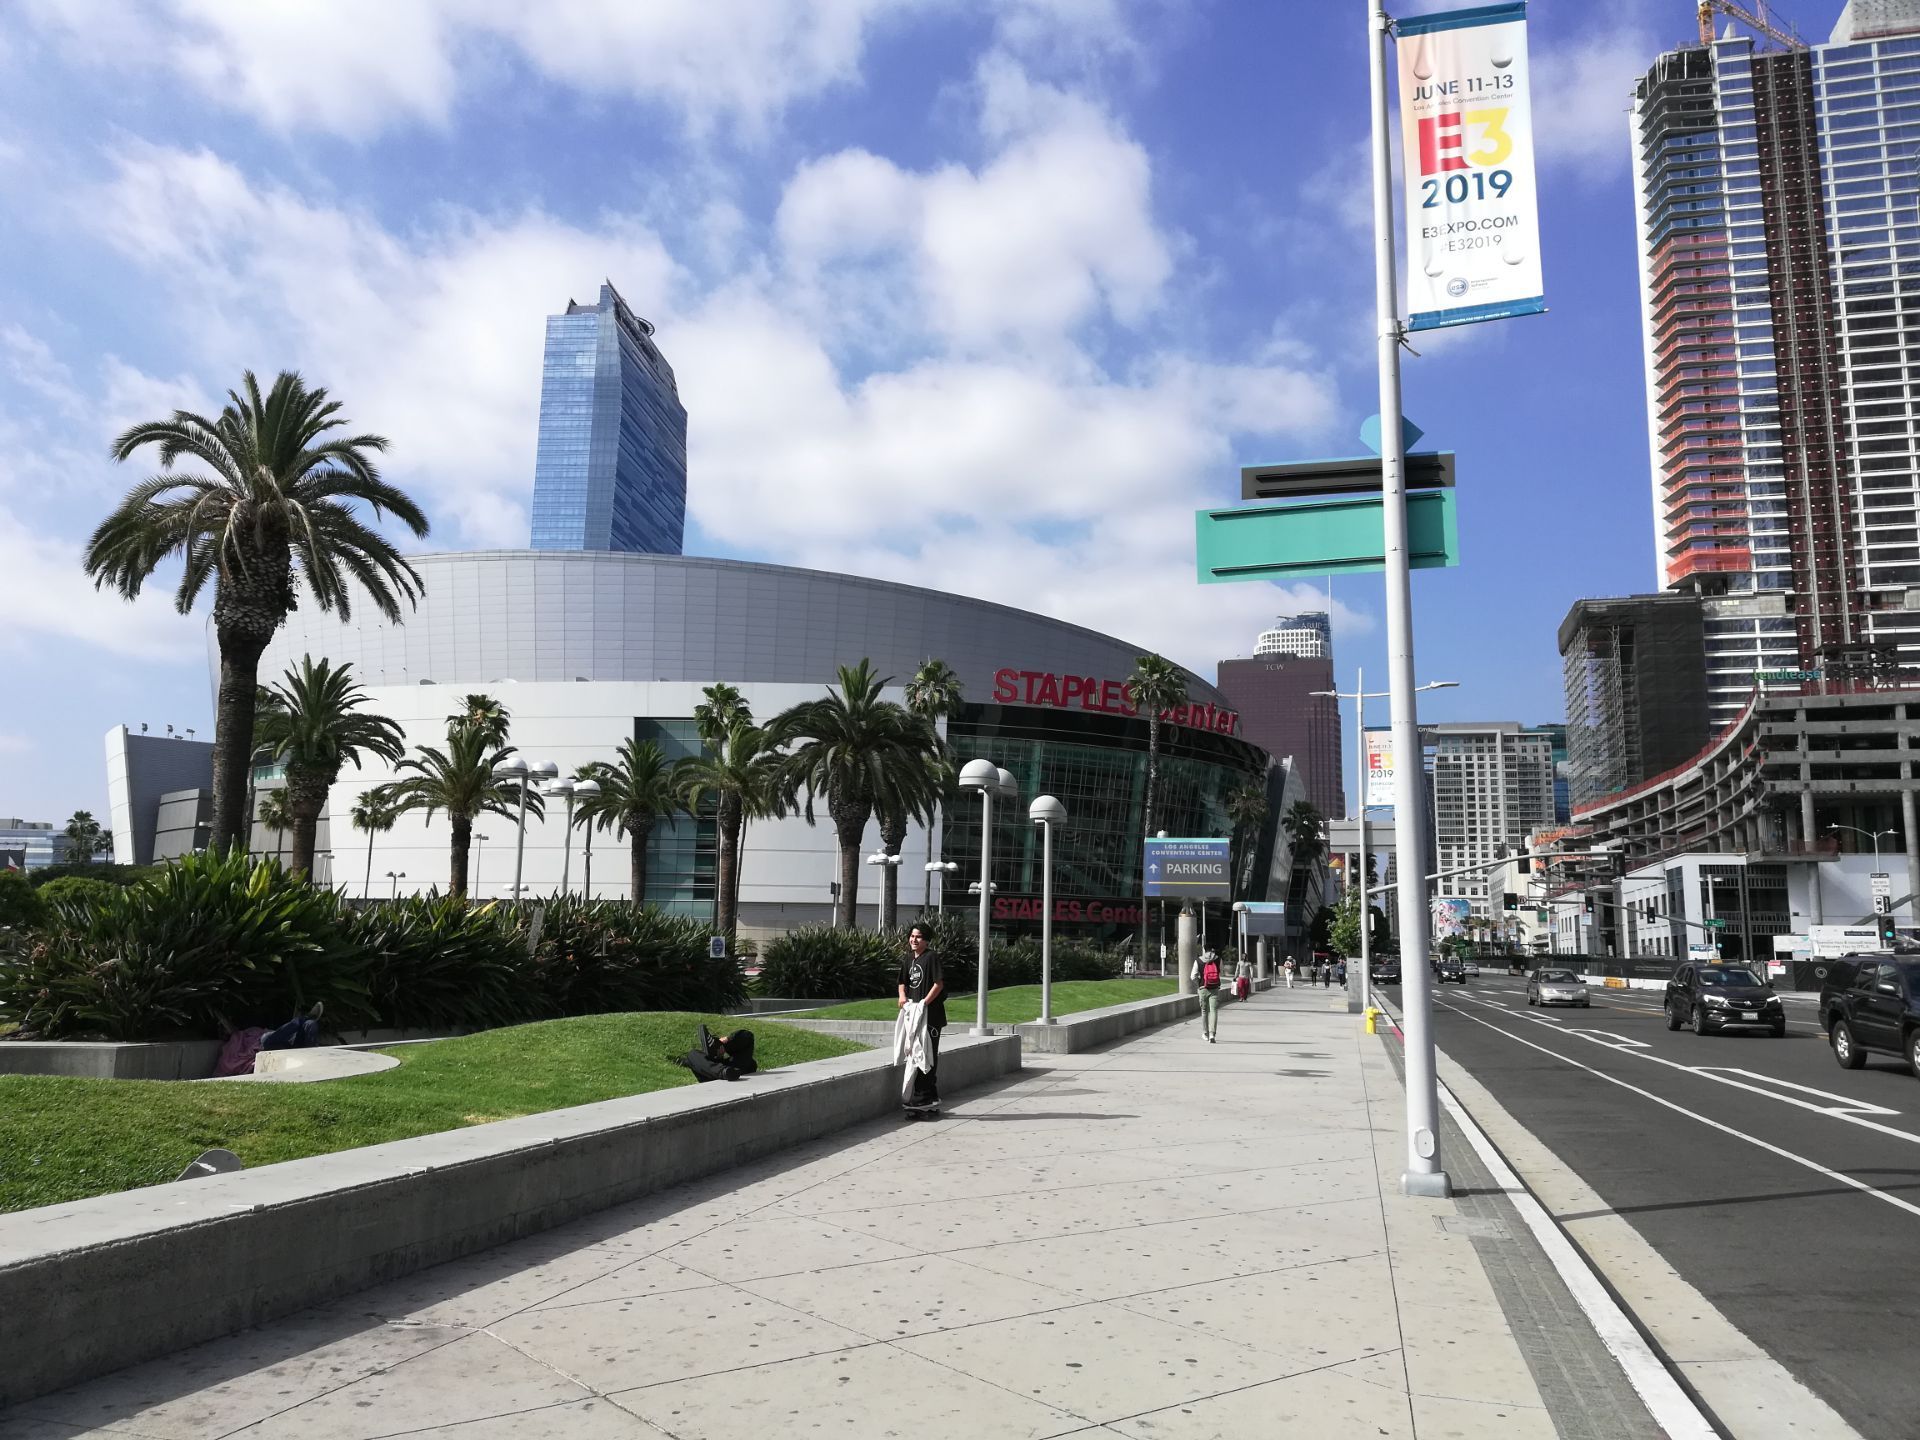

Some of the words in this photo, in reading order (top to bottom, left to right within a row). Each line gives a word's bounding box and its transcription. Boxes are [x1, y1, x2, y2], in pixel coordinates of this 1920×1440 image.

[1412, 80, 1459, 101] JUNE
[1466, 74, 1514, 93] 11-13
[1418, 107, 1513, 177] E3
[1421, 169, 1513, 208] 2019
[1422, 215, 1518, 239] E3EXPO.COM
[1264, 663, 1285, 671] TCW
[992, 667, 1138, 717] STAPLES
[1369, 753, 1394, 770] E3
[1370, 769, 1394, 778] 2019
[1166, 863, 1222, 874] PARKING
